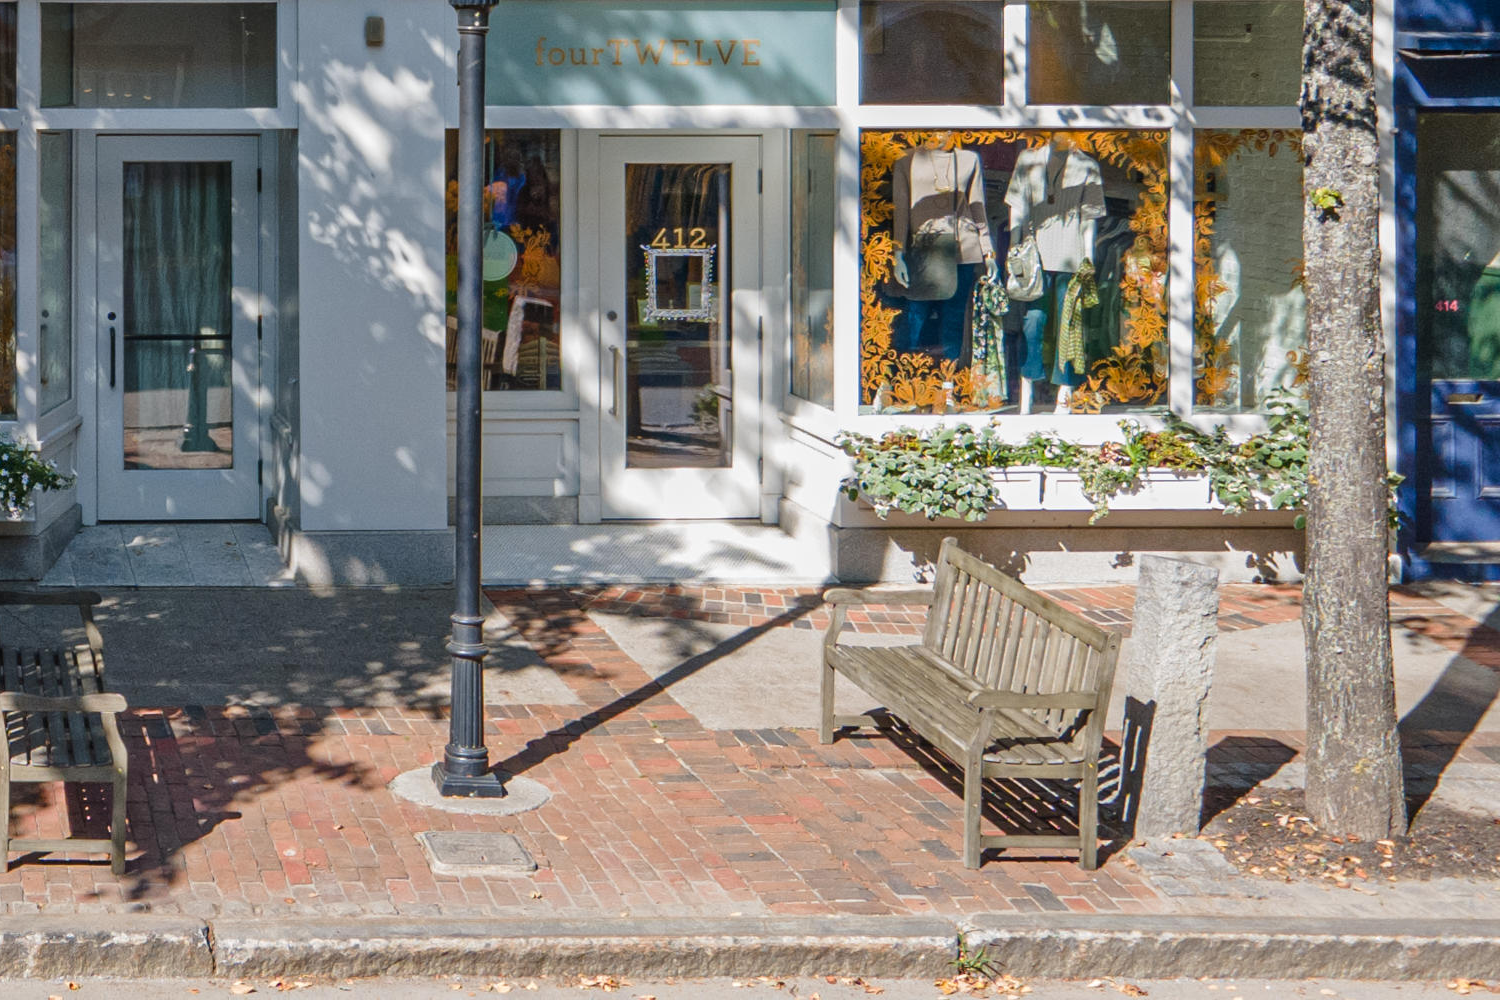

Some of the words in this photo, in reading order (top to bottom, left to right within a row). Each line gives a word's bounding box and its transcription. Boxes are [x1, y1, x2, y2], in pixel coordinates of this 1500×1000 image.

[534, 36, 762, 67] fourTWELVE
[651, 227, 707, 252] 412
[1435, 299, 1459, 312] 414
